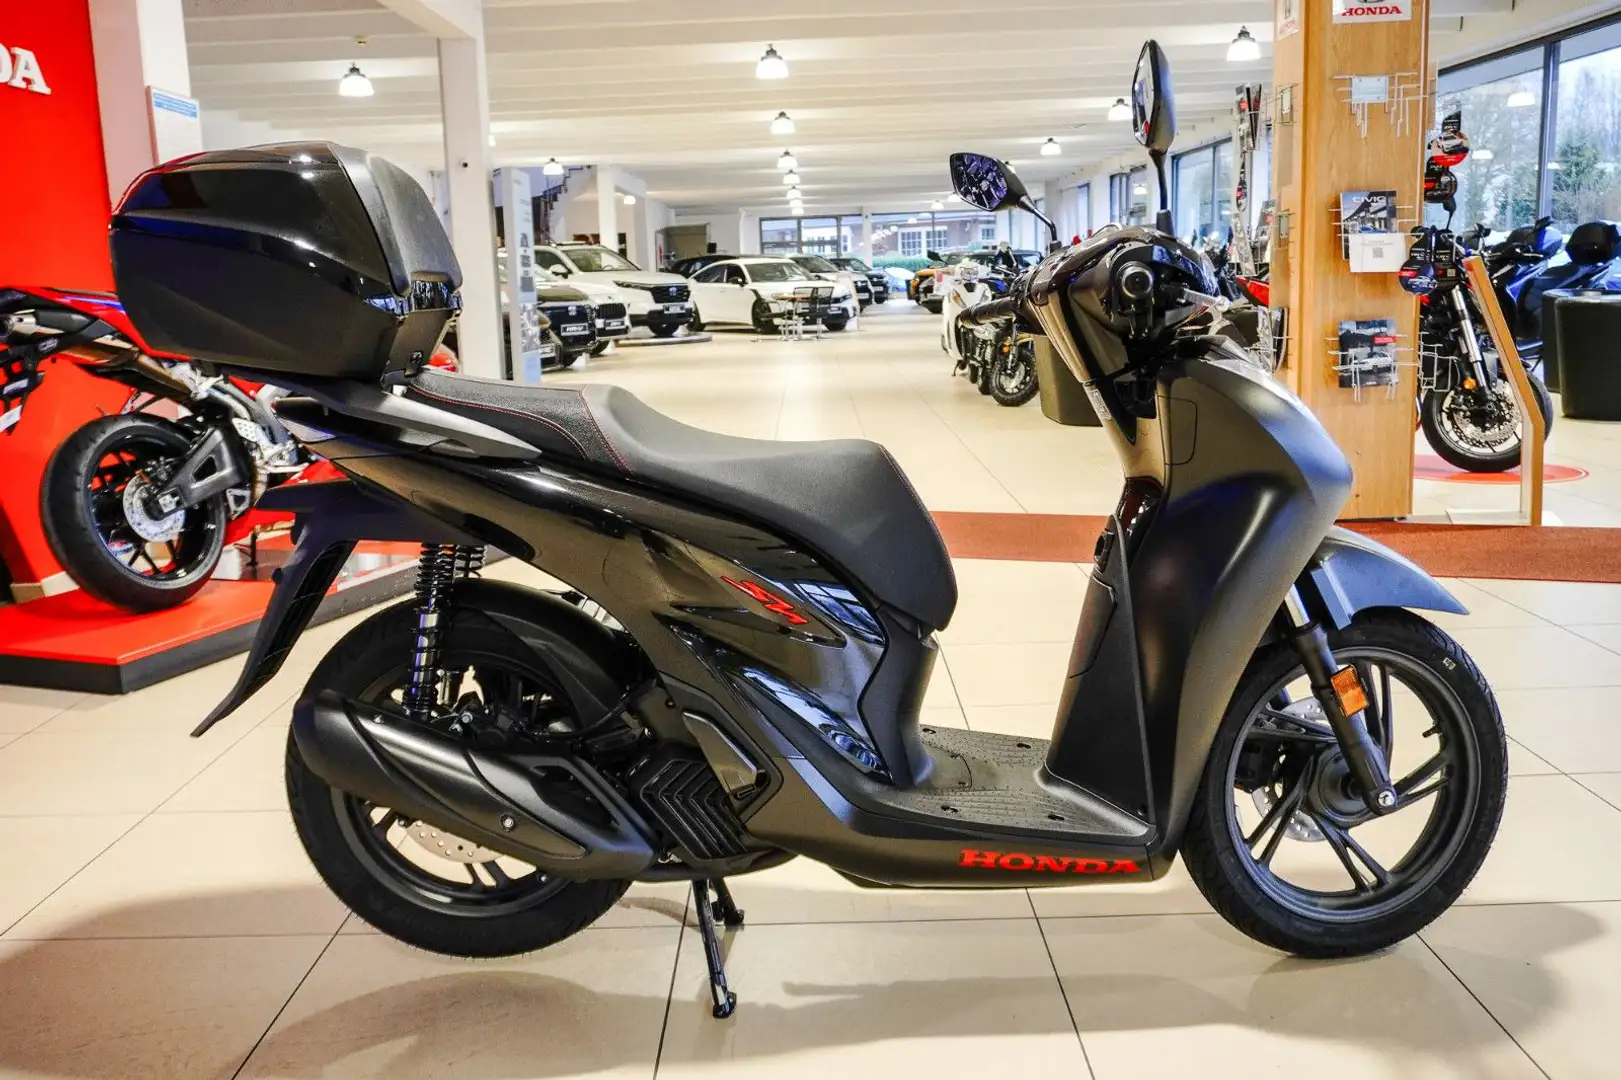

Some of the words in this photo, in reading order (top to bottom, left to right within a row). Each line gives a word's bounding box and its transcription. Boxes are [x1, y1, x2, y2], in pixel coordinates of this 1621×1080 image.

[1341, 6, 1402, 17] HONDA
[1352, 195, 1387, 203] CIVIC
[958, 850, 1142, 873] HONDA
